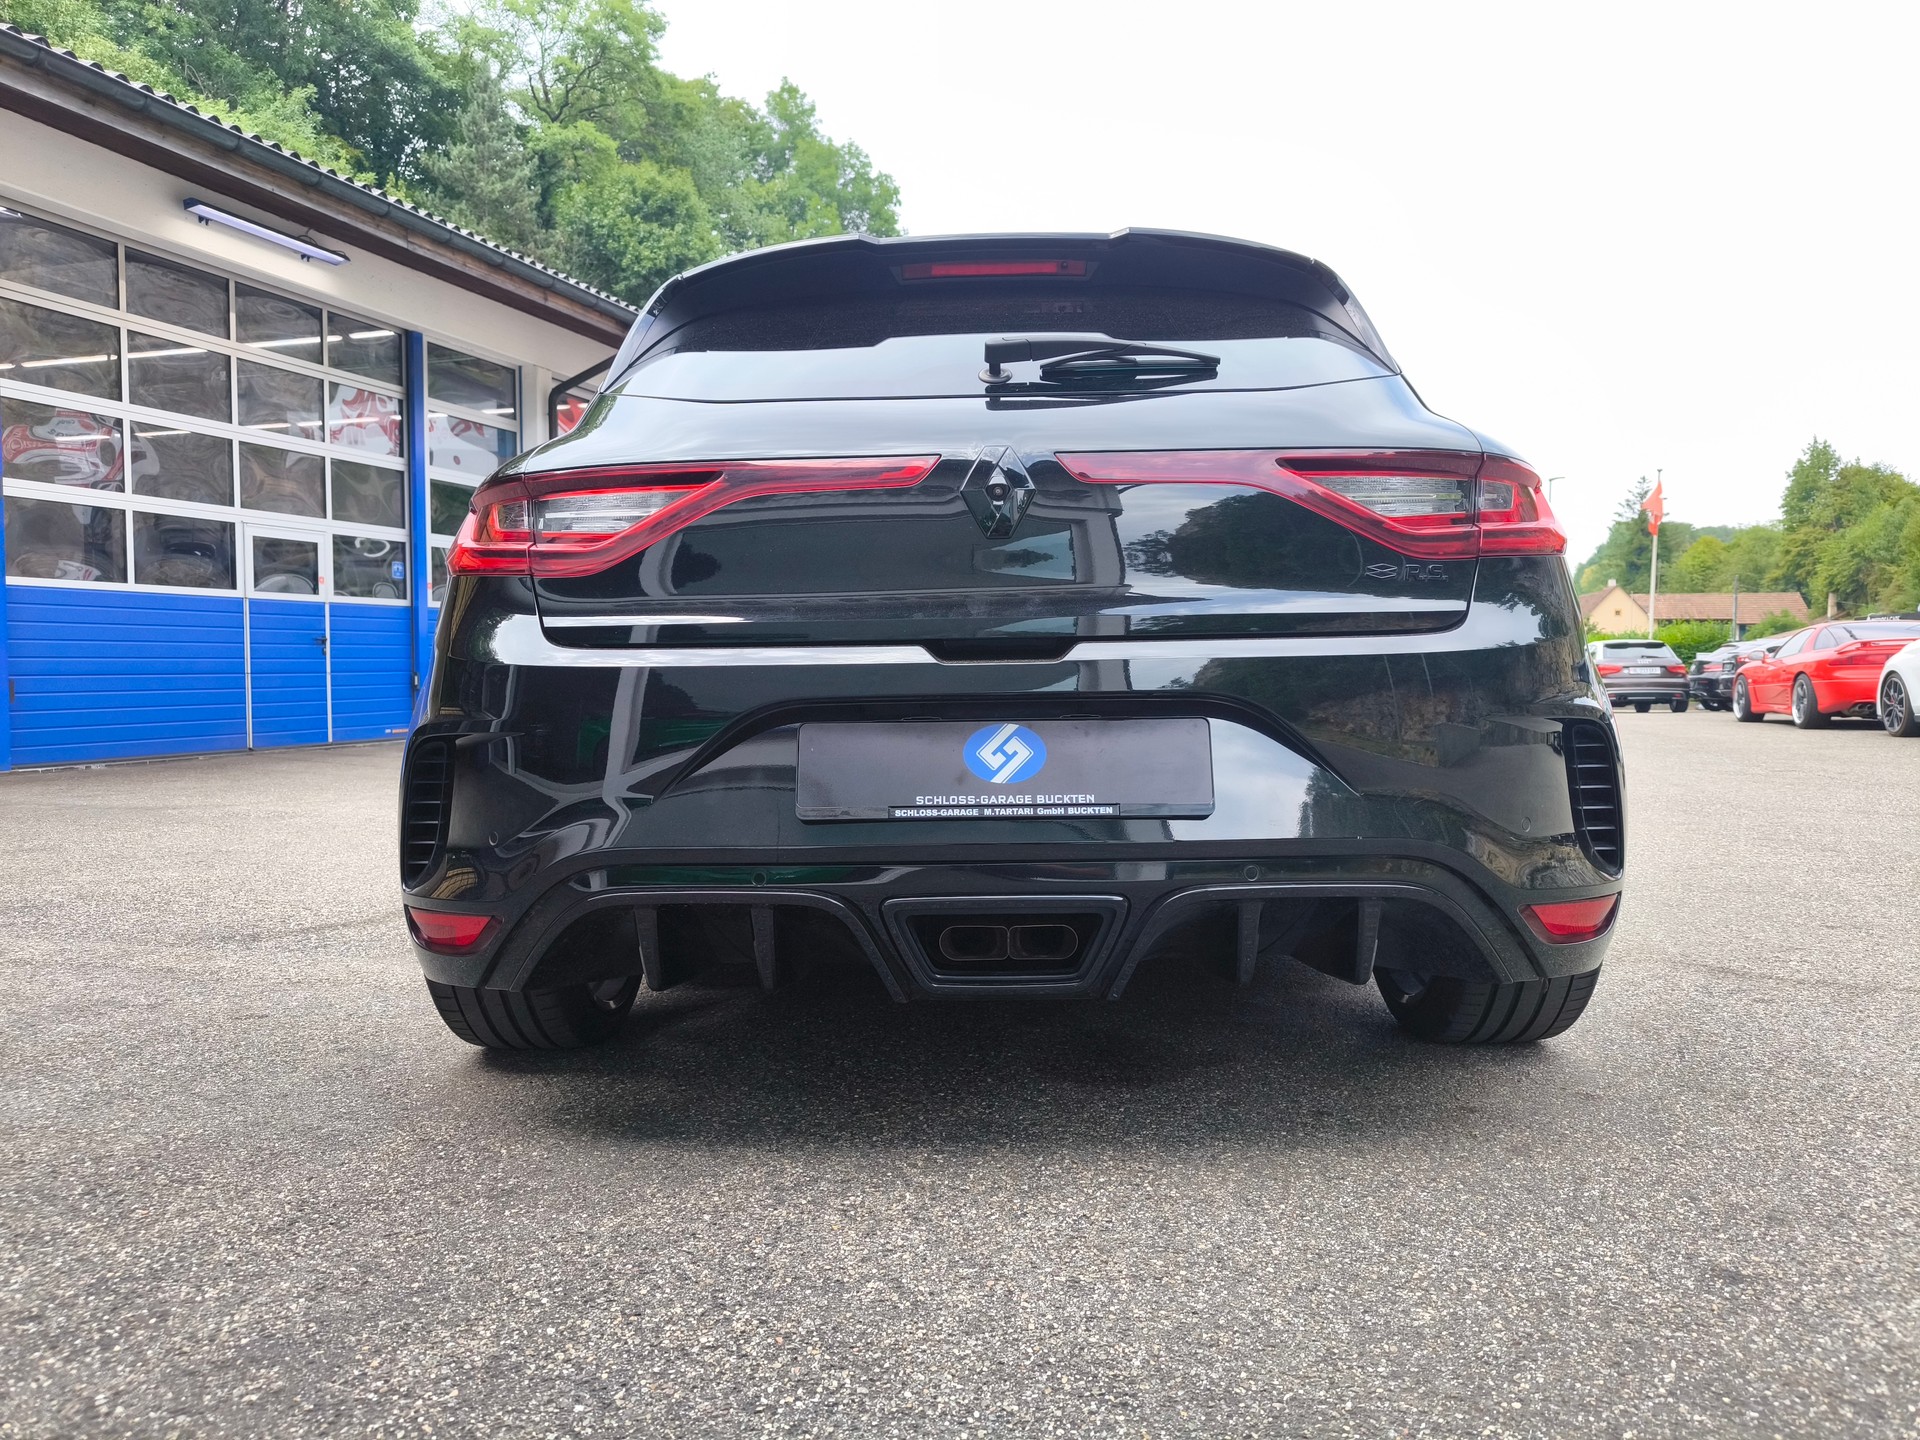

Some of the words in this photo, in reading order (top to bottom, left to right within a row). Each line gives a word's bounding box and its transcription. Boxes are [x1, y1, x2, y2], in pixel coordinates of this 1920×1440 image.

[915, 795, 1033, 805] SCHLOSS-GARAGE
[1036, 794, 1095, 804] BUCKTEN
[894, 808, 979, 817] SCHLOSS-GARAGE
[983, 807, 1034, 816] M.TARTARI
[1037, 807, 1065, 815] GmbH
[1067, 806, 1113, 815] BUCKTEN
